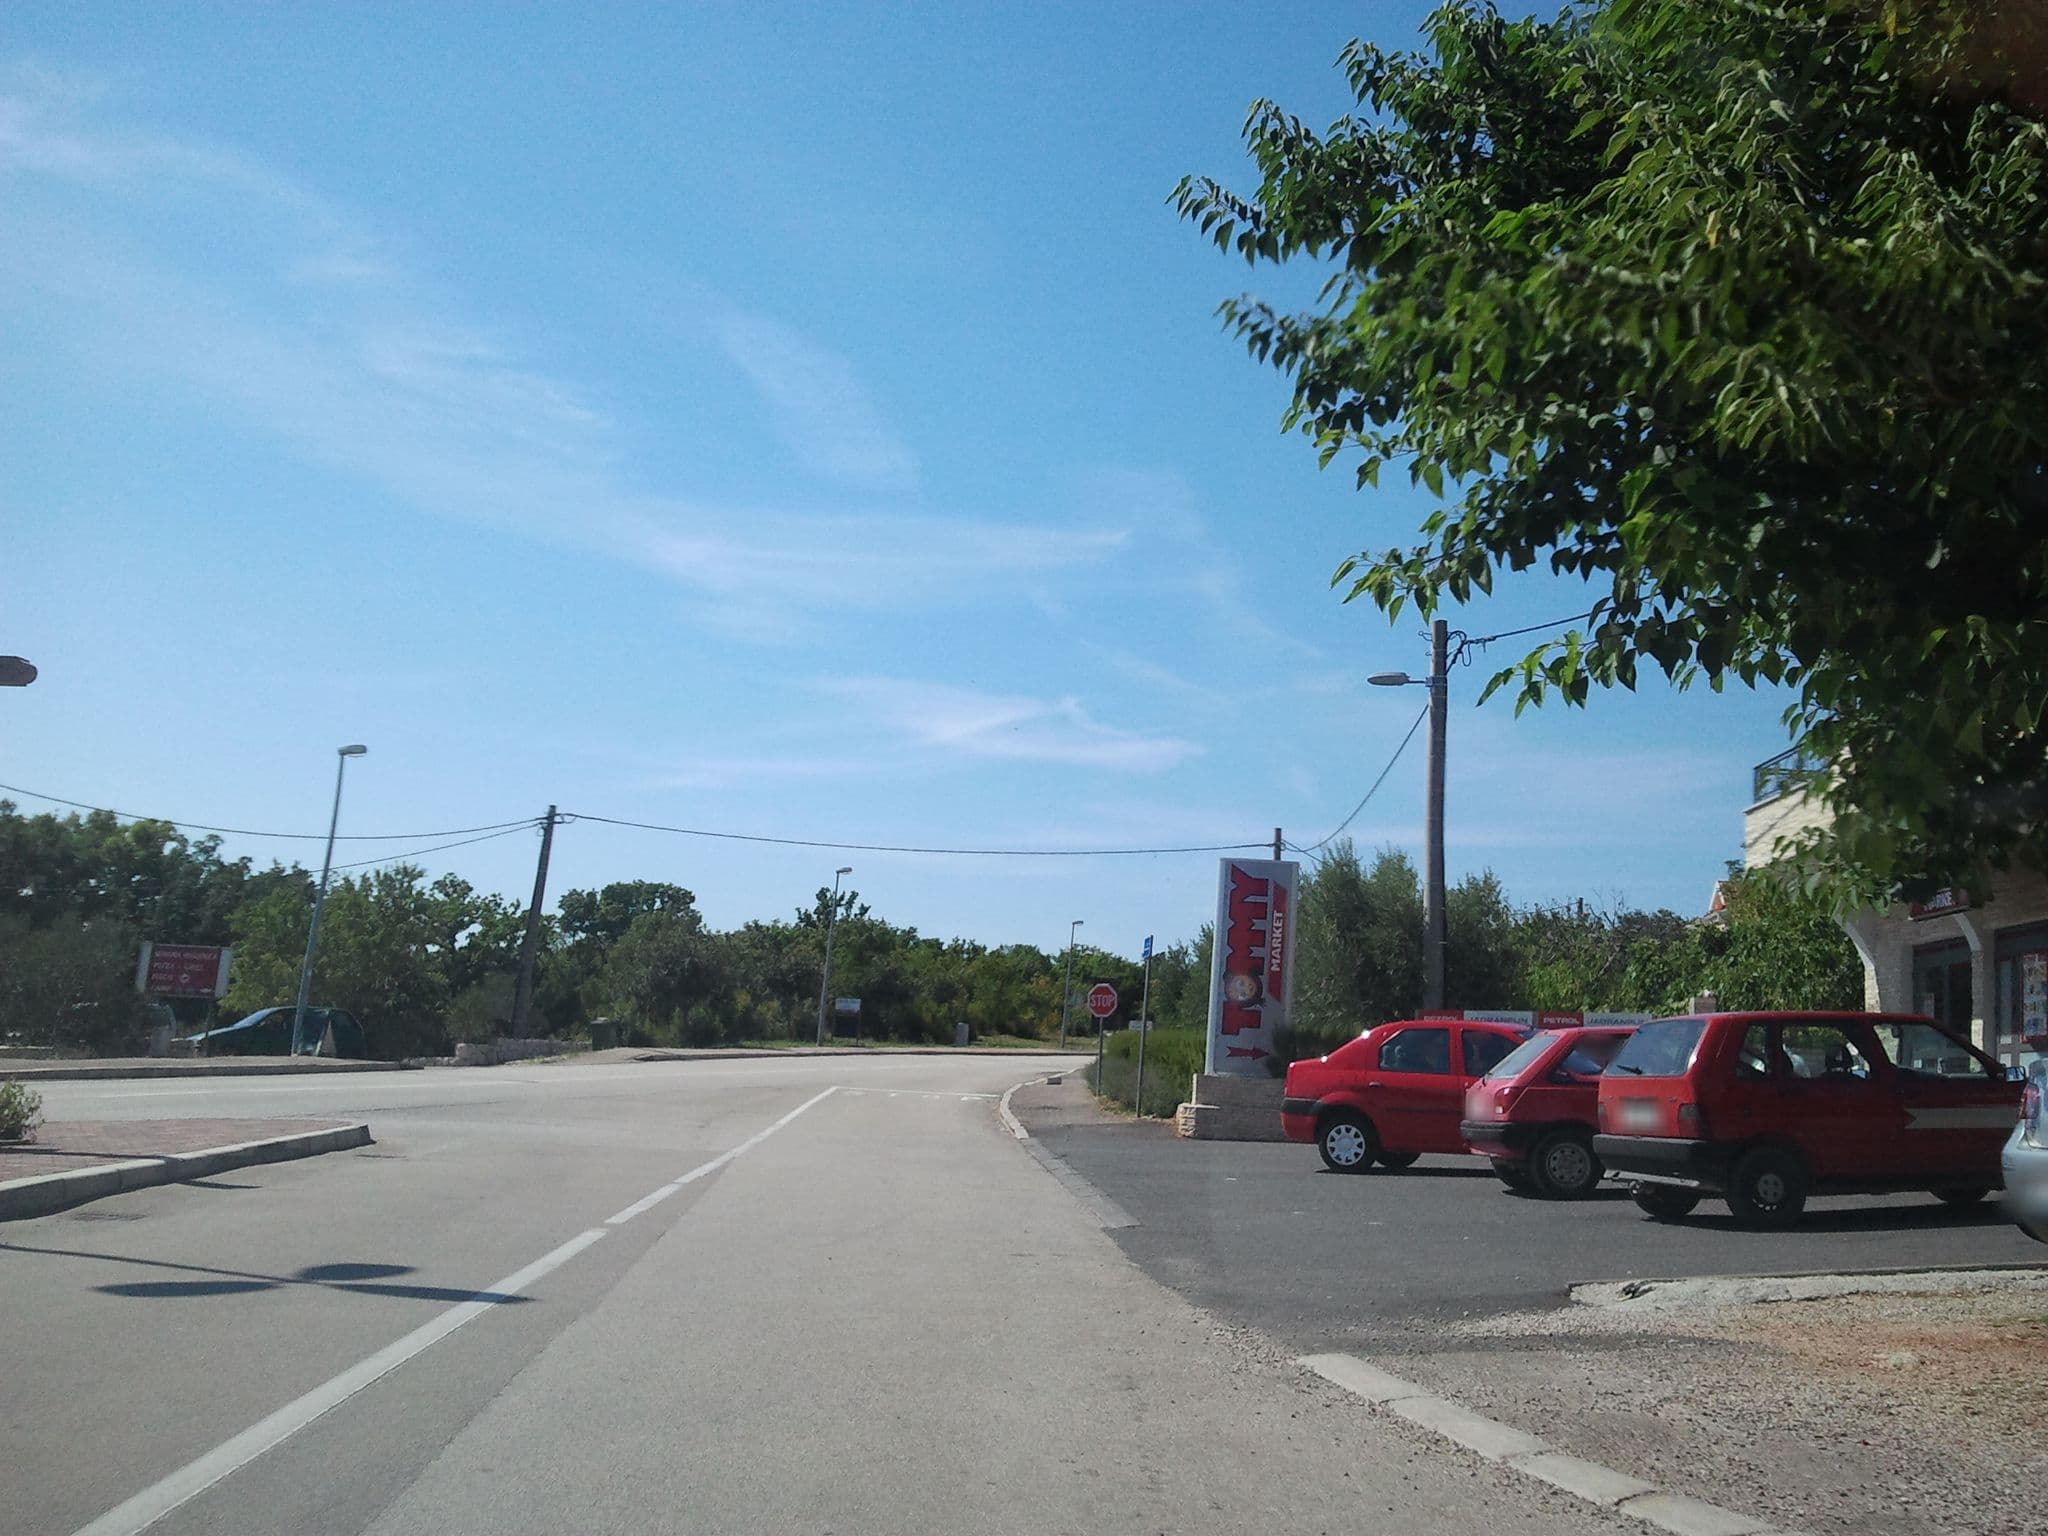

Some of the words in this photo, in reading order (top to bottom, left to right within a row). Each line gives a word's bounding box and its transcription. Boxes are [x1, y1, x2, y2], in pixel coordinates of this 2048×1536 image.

[1271, 910, 1284, 972] MARKET
[1090, 994, 1115, 1007] STOP
[1543, 1016, 1580, 1025] PETROL
